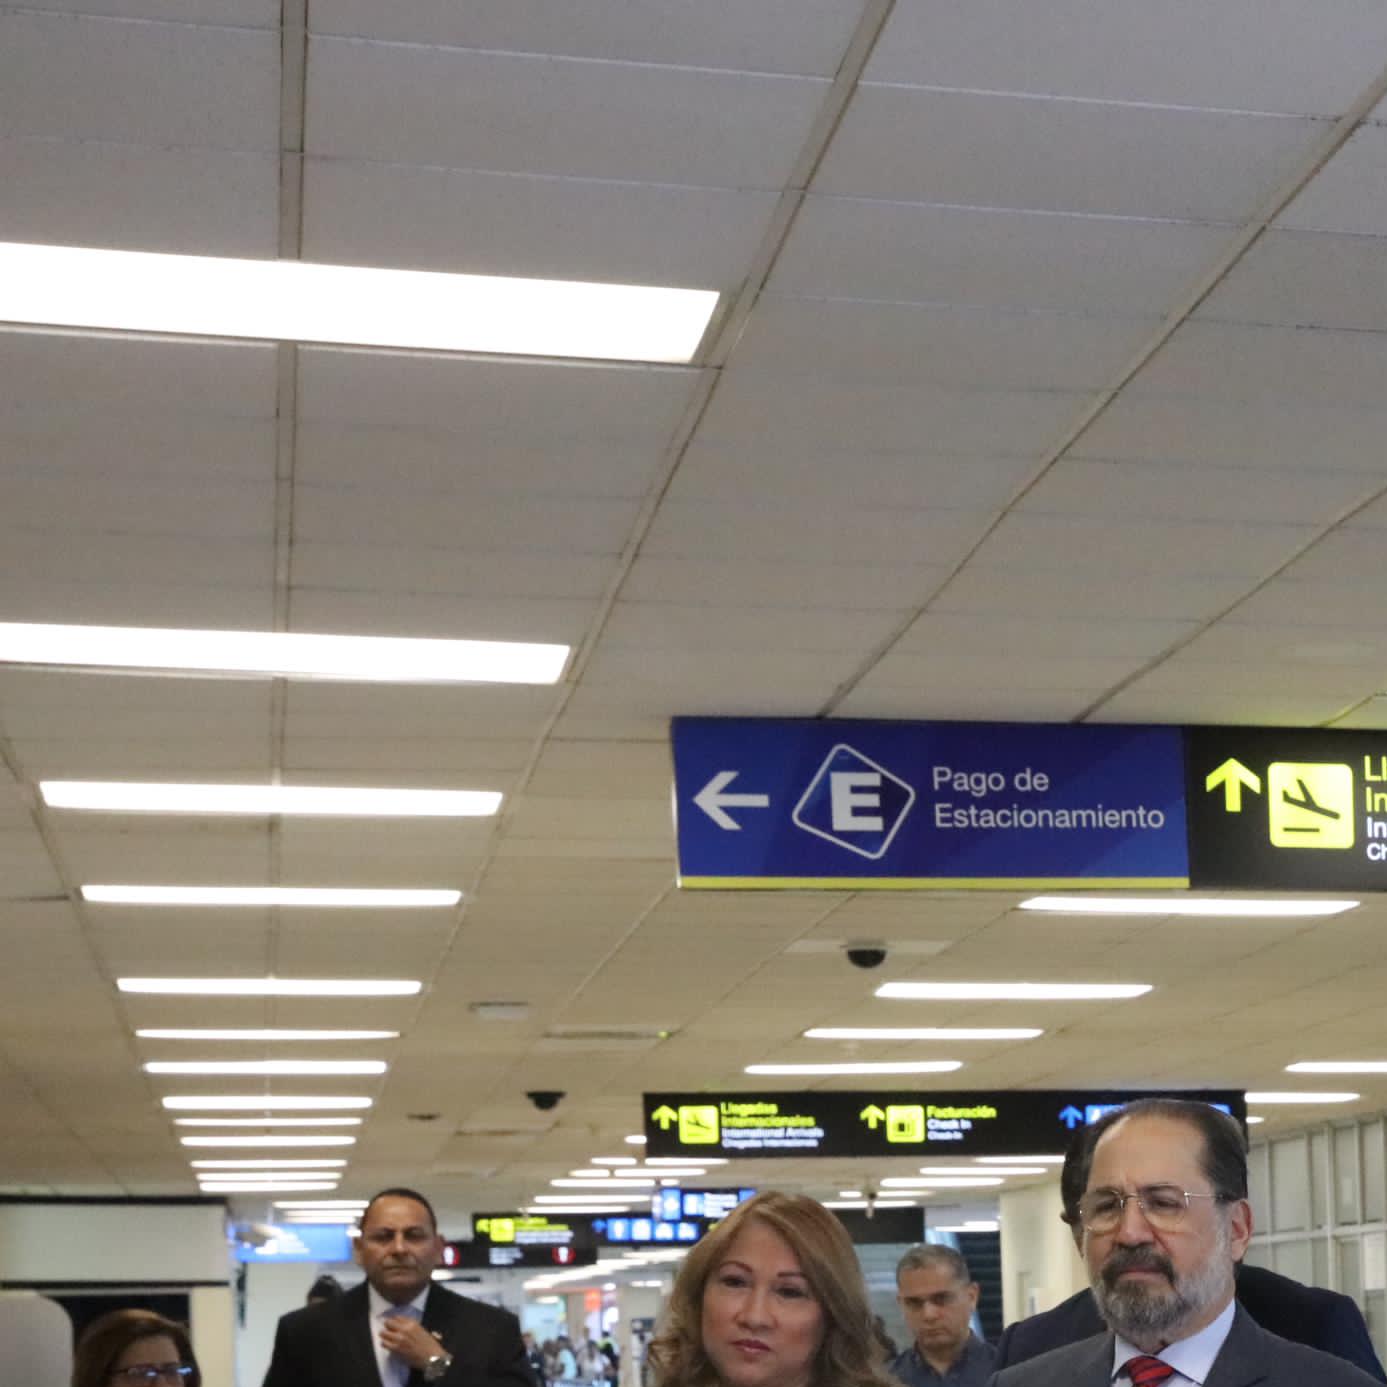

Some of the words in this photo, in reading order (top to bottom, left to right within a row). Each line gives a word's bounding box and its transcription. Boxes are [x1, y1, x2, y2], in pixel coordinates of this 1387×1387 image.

[932, 767, 1005, 796] Pago
[1014, 767, 1050, 792] de
[830, 771, 884, 832] E
[934, 803, 1166, 829] Estacionamiento
